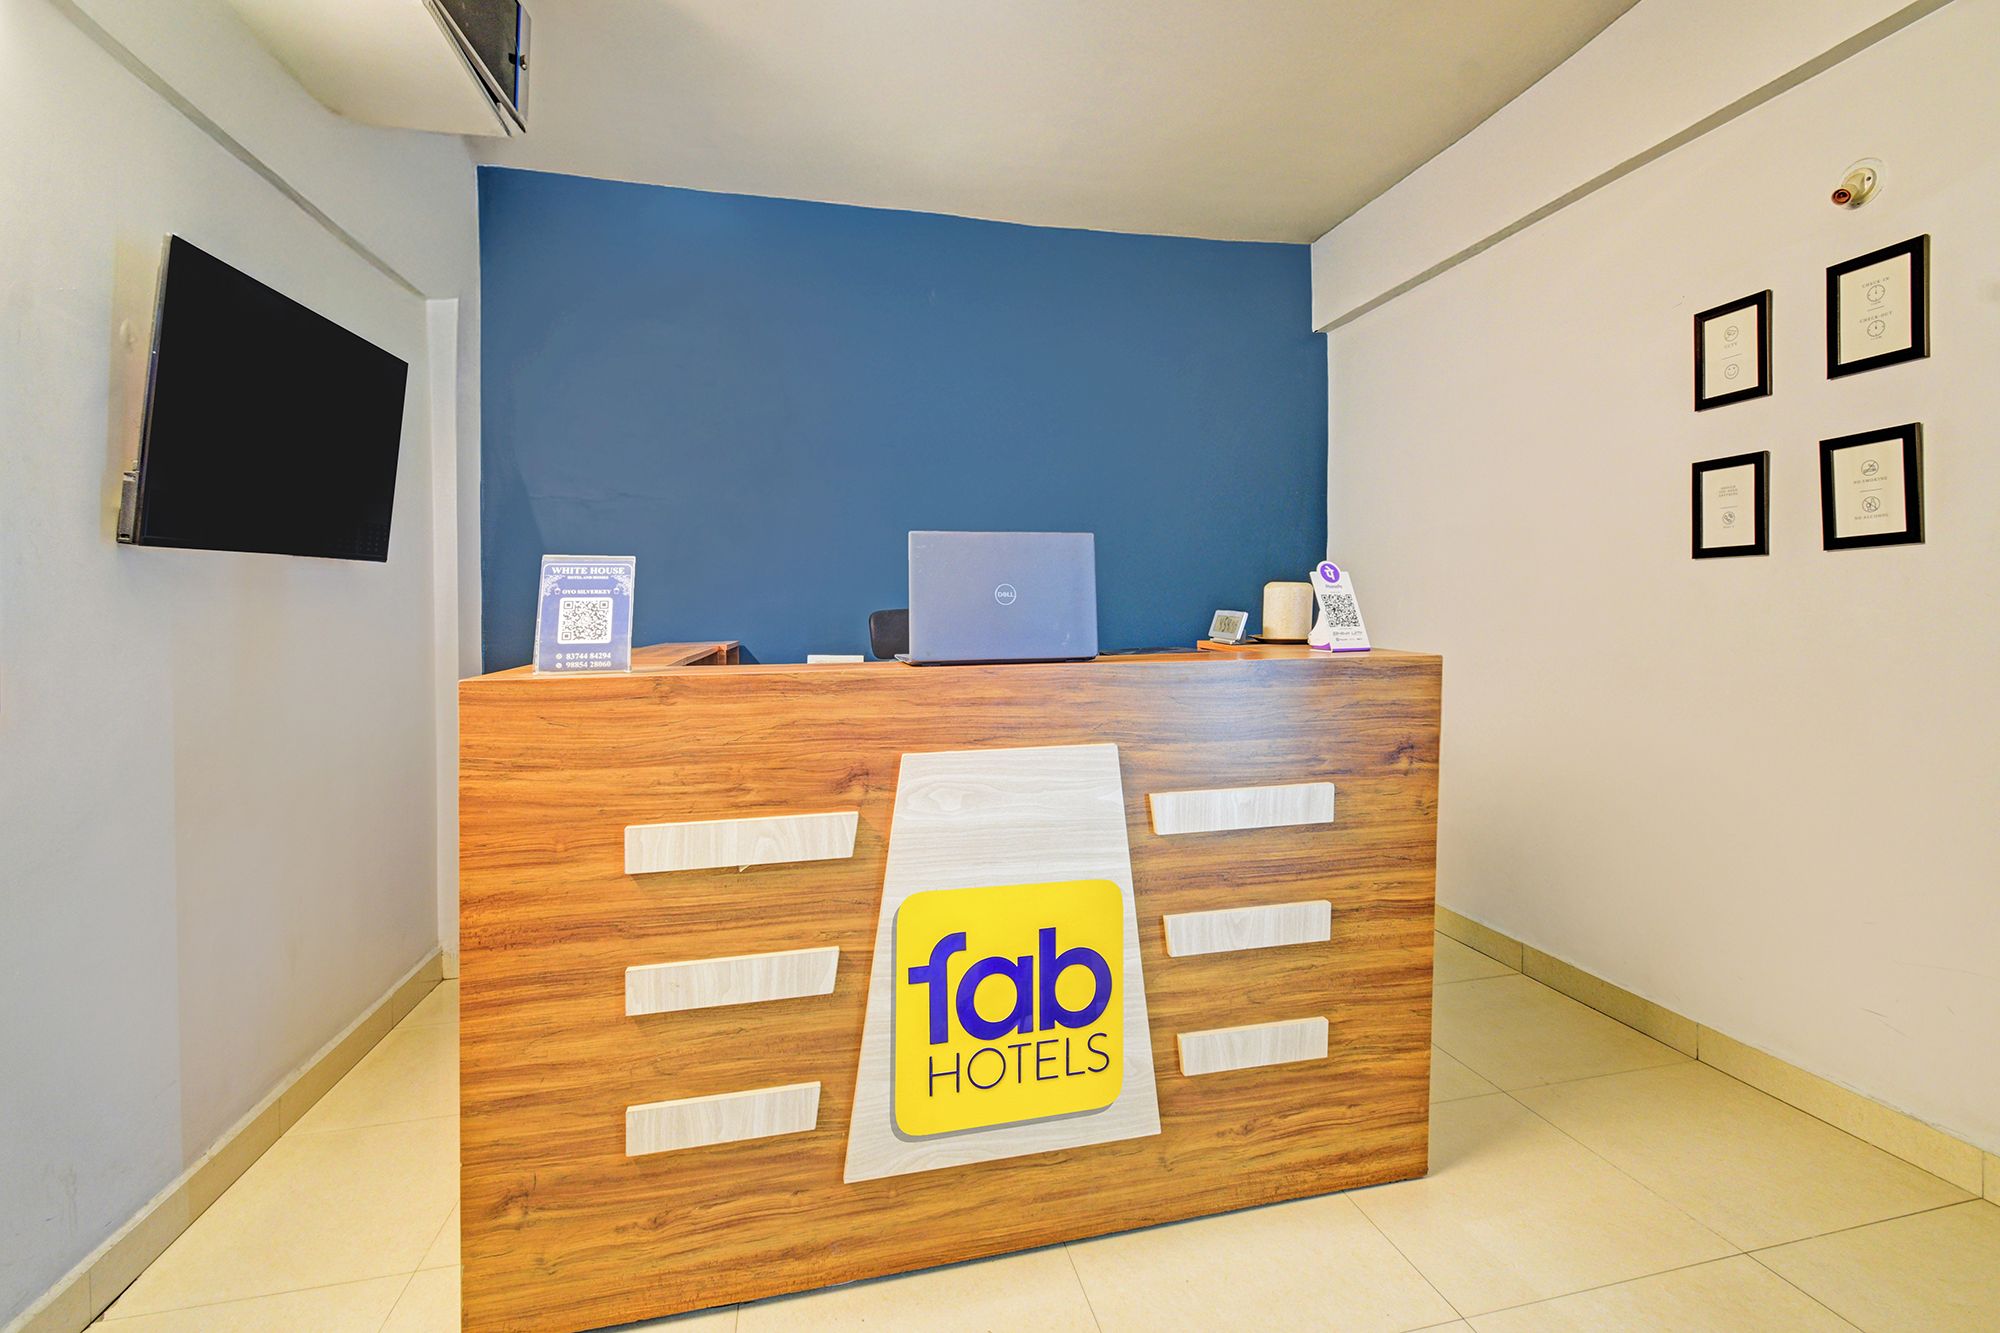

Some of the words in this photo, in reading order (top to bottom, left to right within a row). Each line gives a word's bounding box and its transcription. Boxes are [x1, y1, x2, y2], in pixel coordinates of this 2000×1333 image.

[551, 566, 588, 575] WHITE
[590, 566, 626, 575] HOUSE
[908, 927, 1113, 1046] fab
[929, 1032, 1110, 1097] HOTELS
